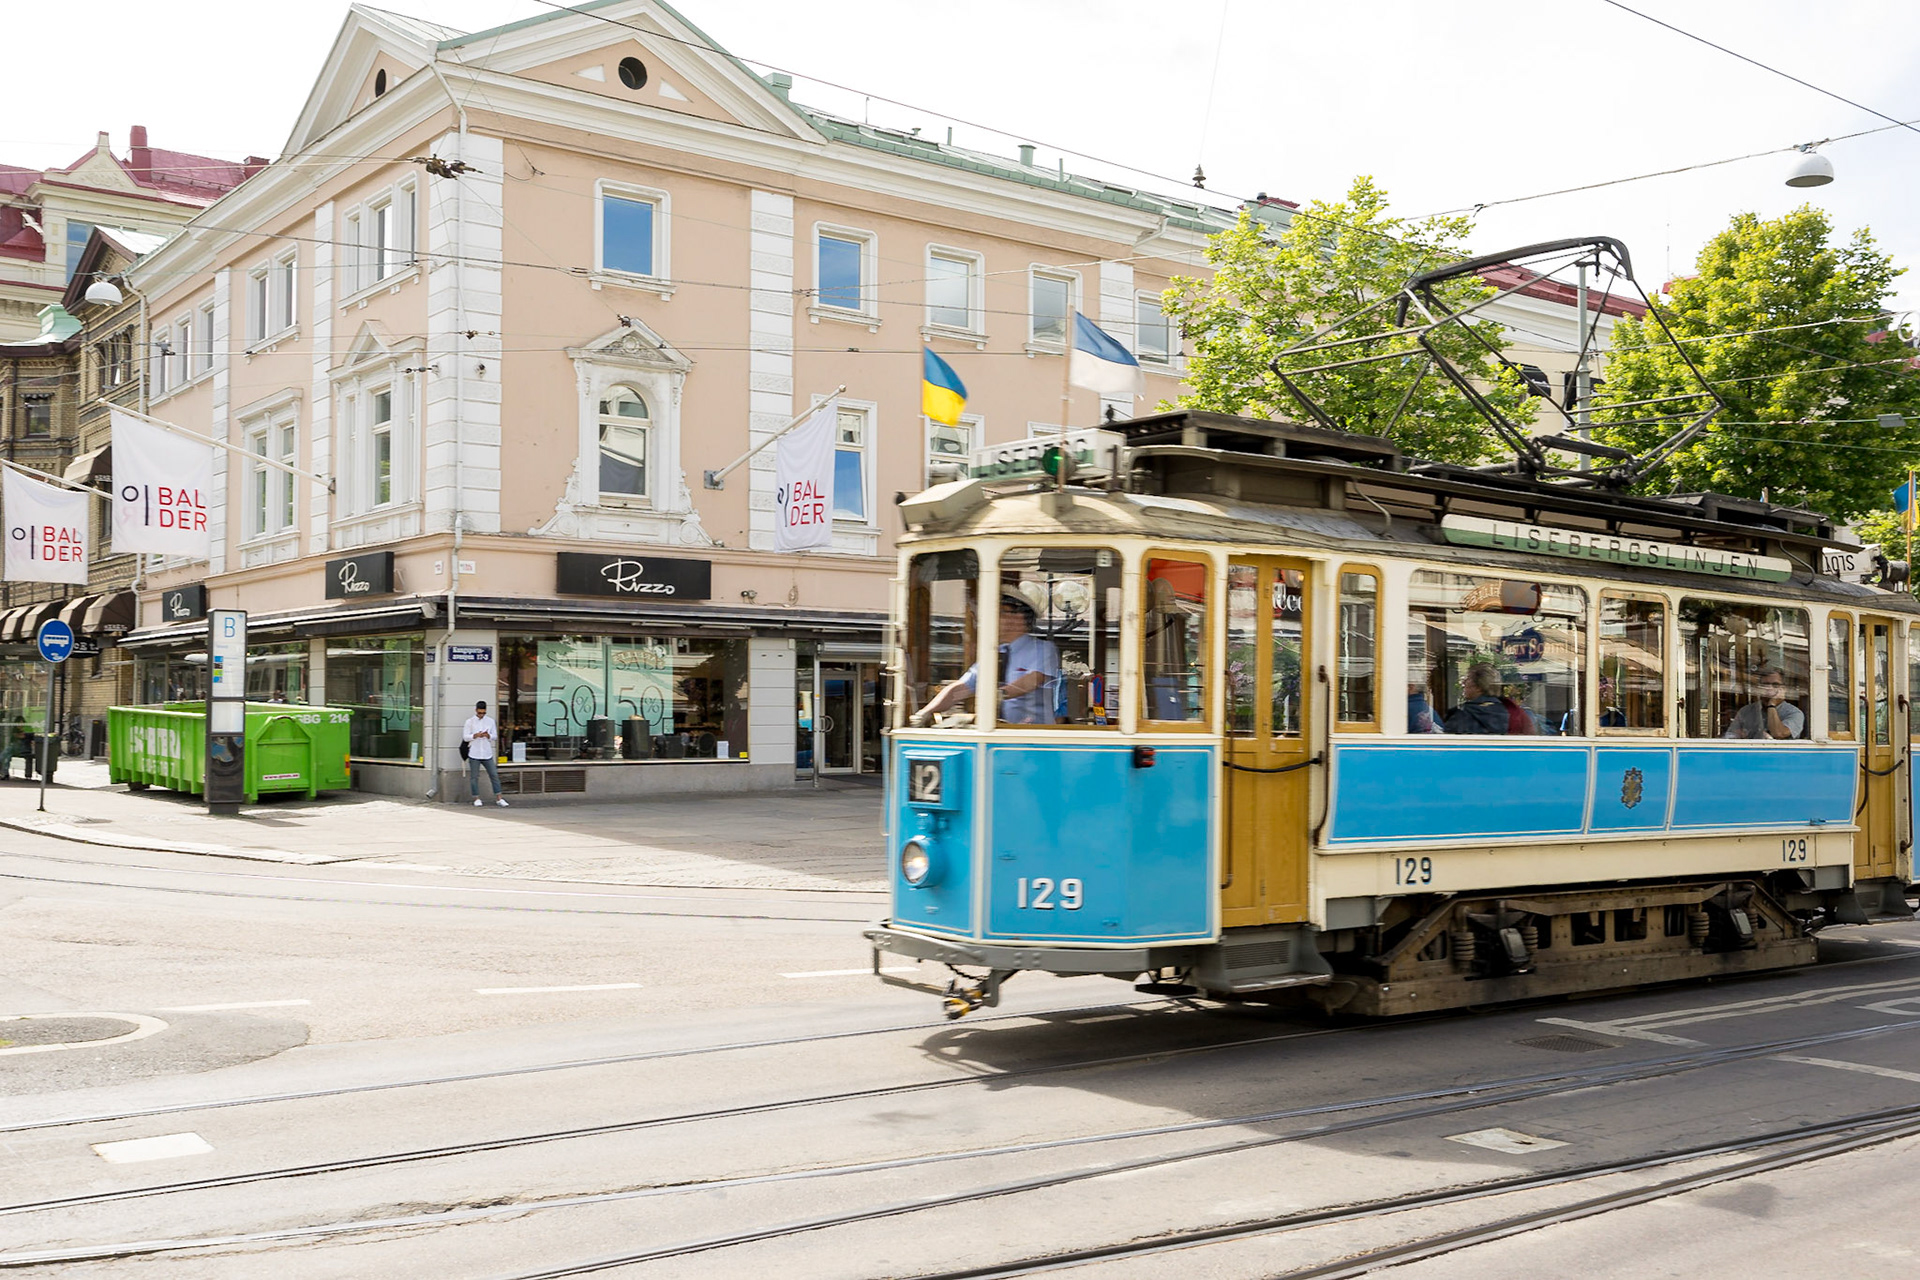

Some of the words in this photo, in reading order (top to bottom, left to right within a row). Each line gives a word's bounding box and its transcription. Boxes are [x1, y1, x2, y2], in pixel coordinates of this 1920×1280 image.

[158, 486, 206, 509] BAL
[793, 479, 825, 502] BAL
[159, 508, 207, 532] DER
[790, 503, 825, 526] DER
[42, 526, 82, 544] BAL
[42, 544, 83, 562] DER
[1491, 523, 1759, 578] LISEBERGSLINJEN
[338, 560, 370, 594] Rizzo
[600, 557, 675, 594] Rizzo
[224, 616, 235, 637] B
[329, 713, 350, 724] 214
[914, 764, 942, 801] 12
[1782, 839, 1807, 862] 129
[1395, 856, 1432, 885] 129
[1017, 877, 1084, 910] 129
